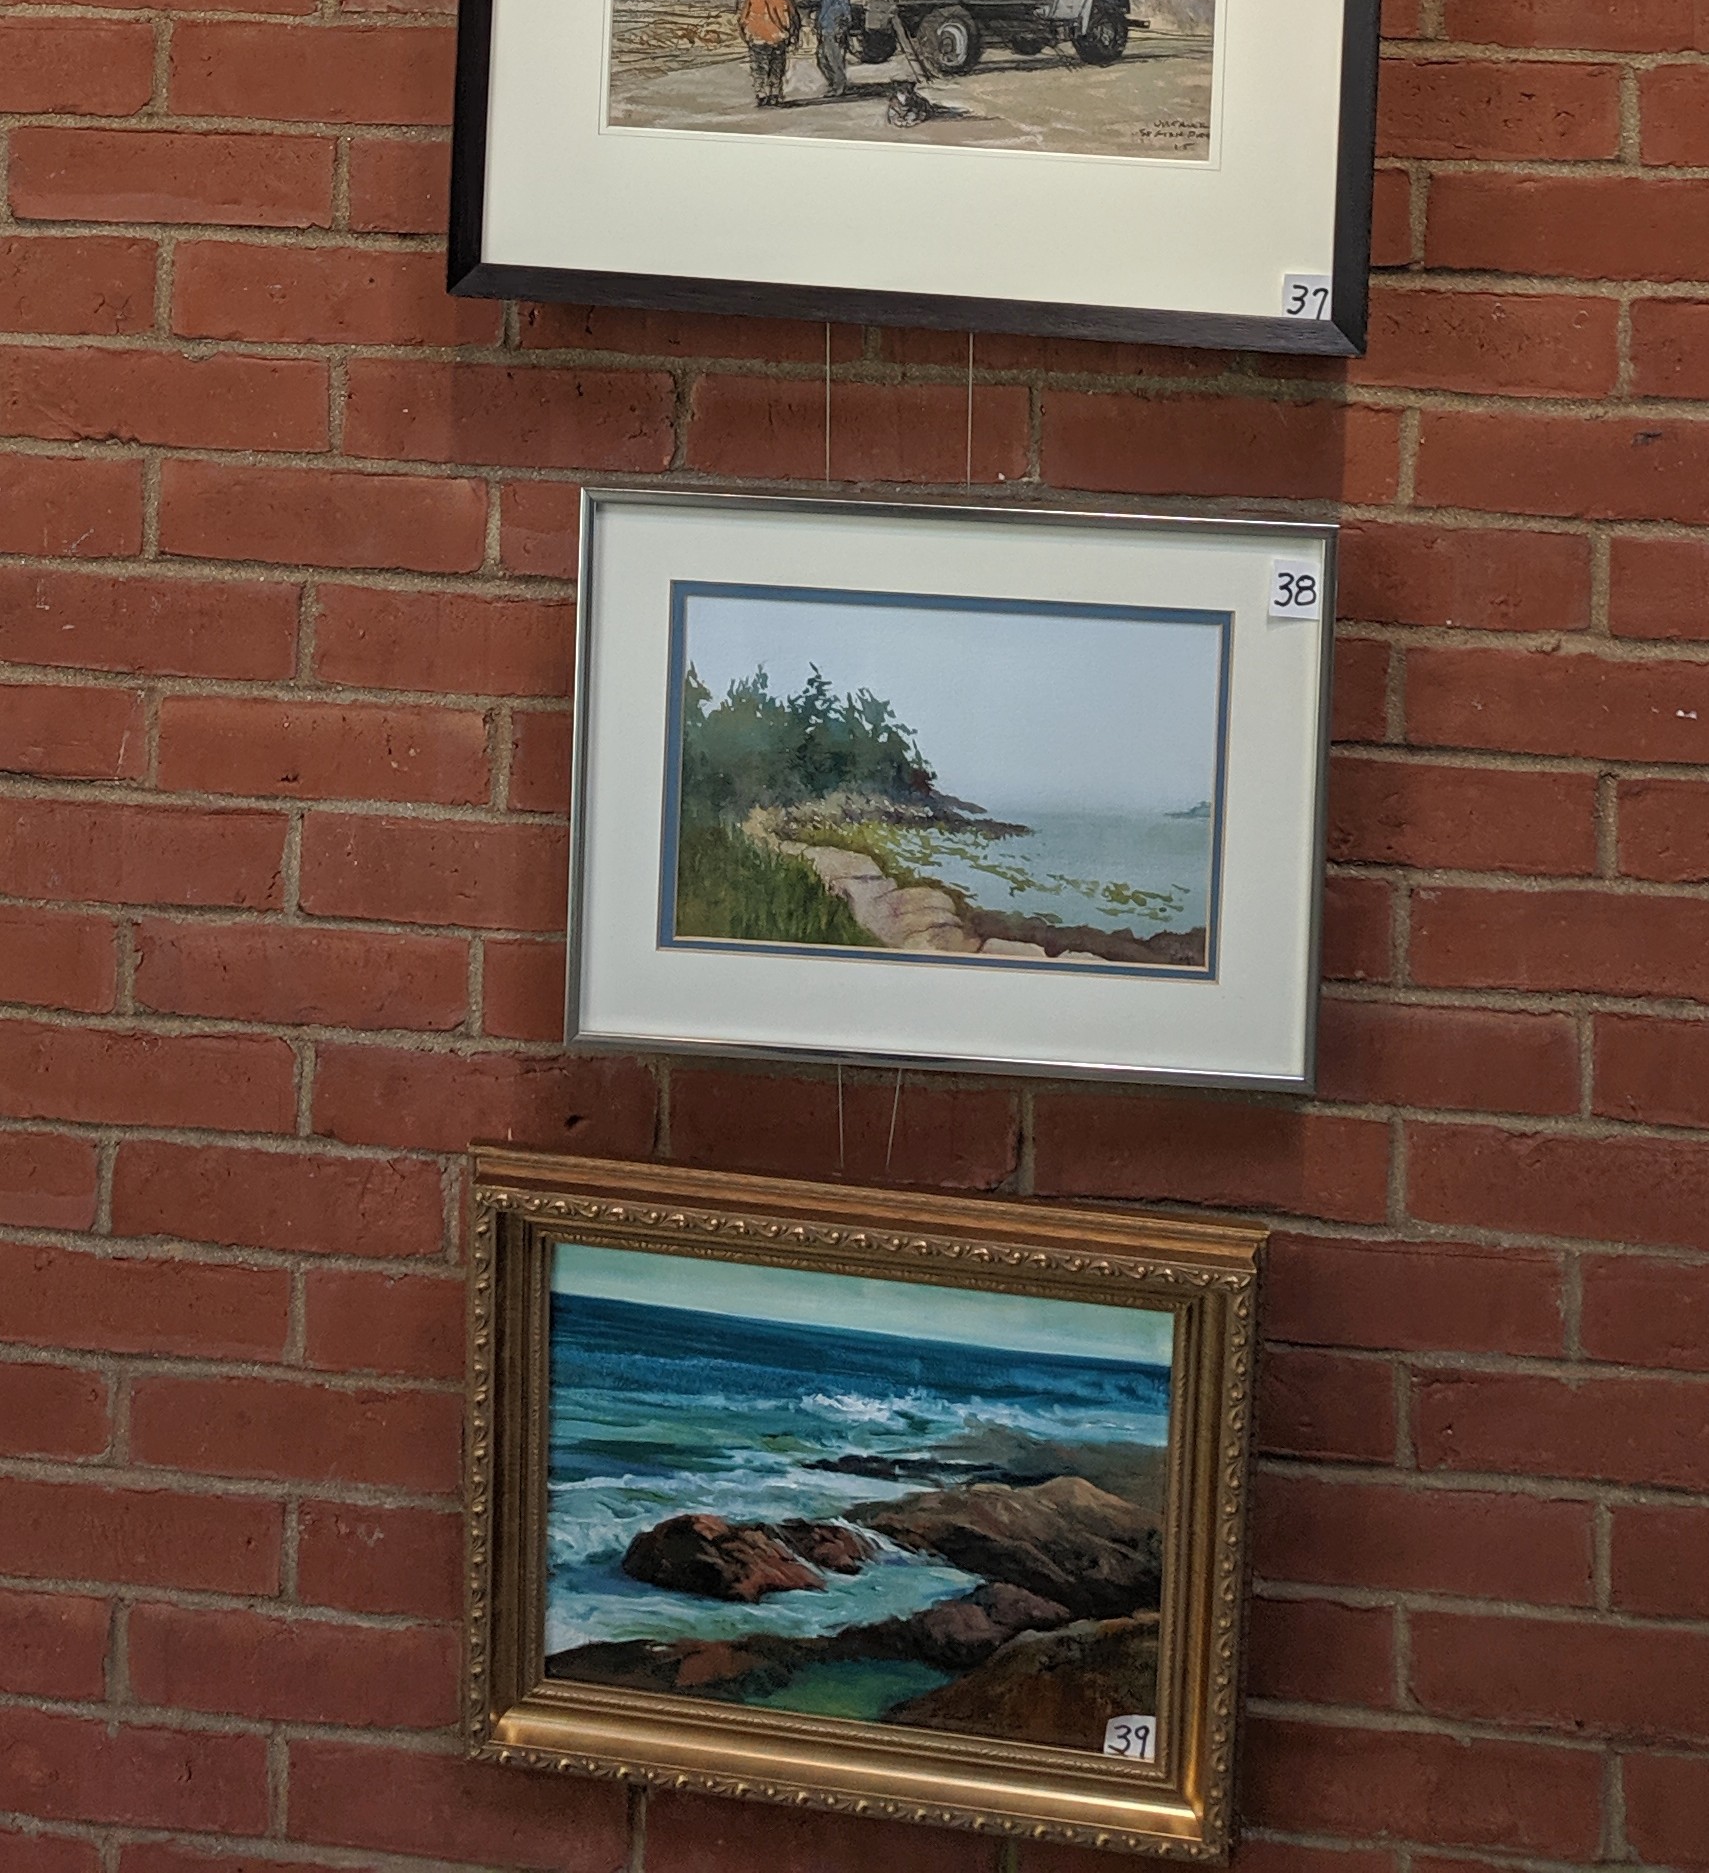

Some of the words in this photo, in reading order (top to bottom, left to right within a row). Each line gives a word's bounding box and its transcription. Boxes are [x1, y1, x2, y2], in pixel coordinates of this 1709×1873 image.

[1286, 283, 1329, 320] 37
[1274, 572, 1317, 607] 38
[1107, 1724, 1150, 1759] 39
